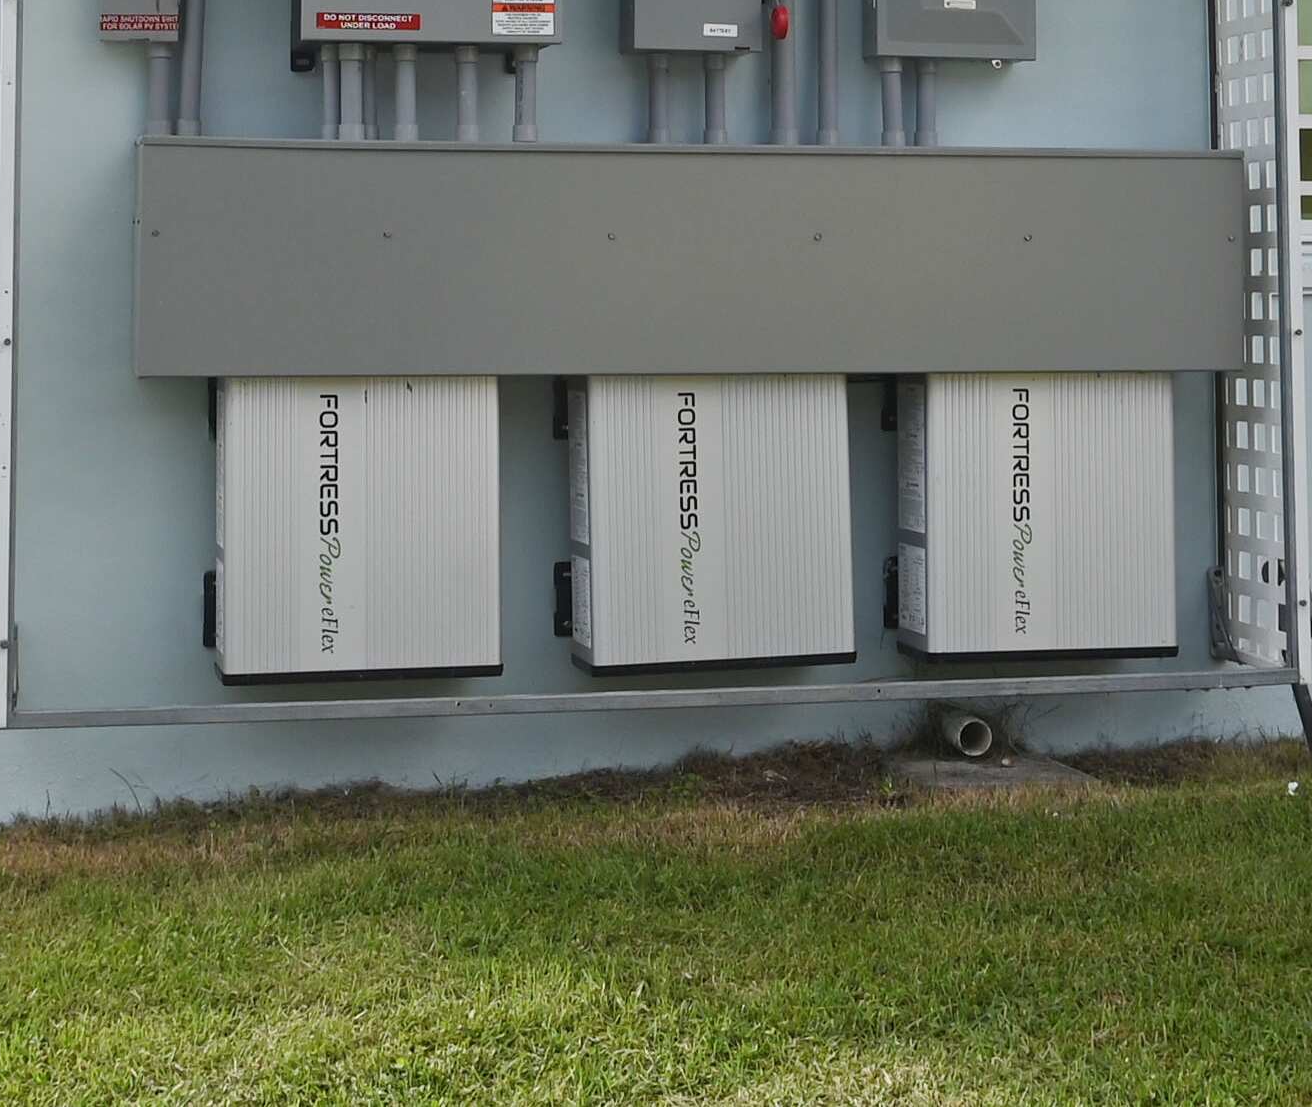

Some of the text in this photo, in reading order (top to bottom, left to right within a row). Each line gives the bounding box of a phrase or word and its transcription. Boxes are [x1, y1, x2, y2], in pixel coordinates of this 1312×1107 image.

[358, 14, 413, 22] DISCONNECT
[319, 394, 341, 654] FORTRESS Power eFlex
[677, 393, 701, 645] FORTRESS Power eFlex
[1011, 388, 1033, 635] FORTRESS Power eFlex
